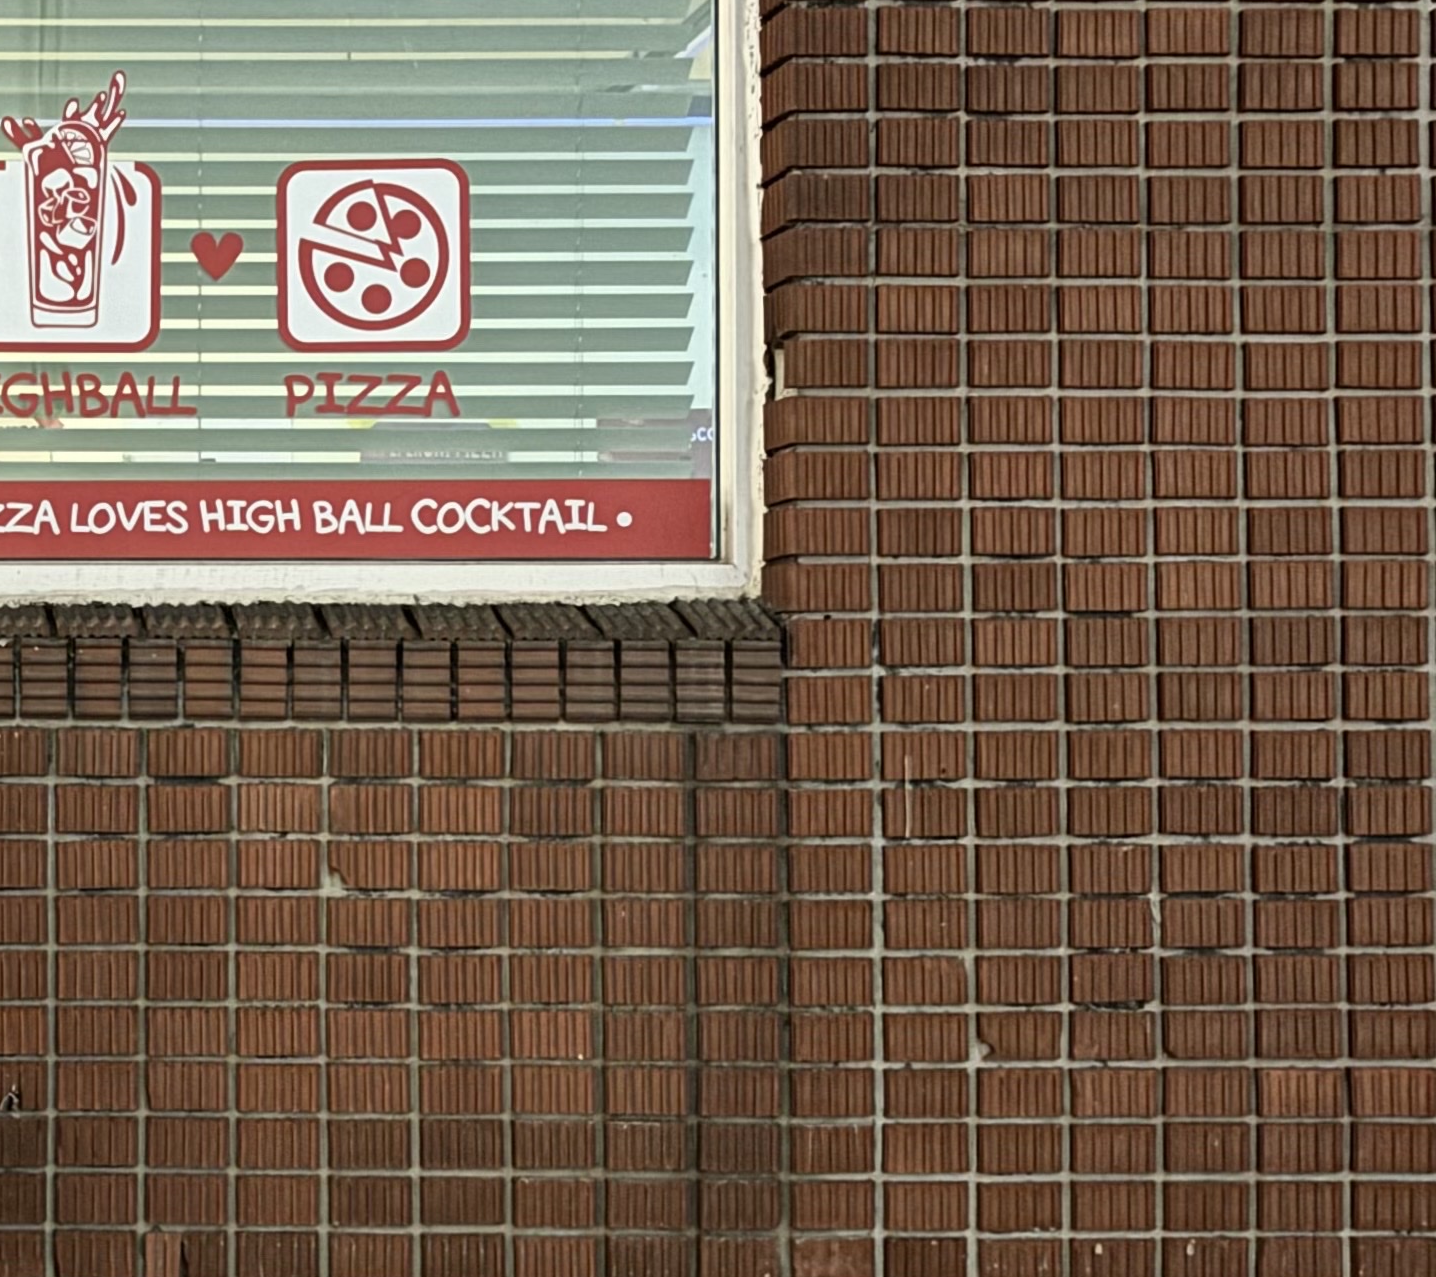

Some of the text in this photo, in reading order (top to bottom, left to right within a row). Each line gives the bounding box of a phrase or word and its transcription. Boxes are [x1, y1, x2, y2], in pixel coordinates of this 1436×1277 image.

[284, 372, 460, 417] PIZZA
[70, 500, 189, 535] LOVES
[199, 498, 301, 534] HIGH
[312, 499, 404, 535] BALL
[410, 497, 608, 535] COCKTAIL
